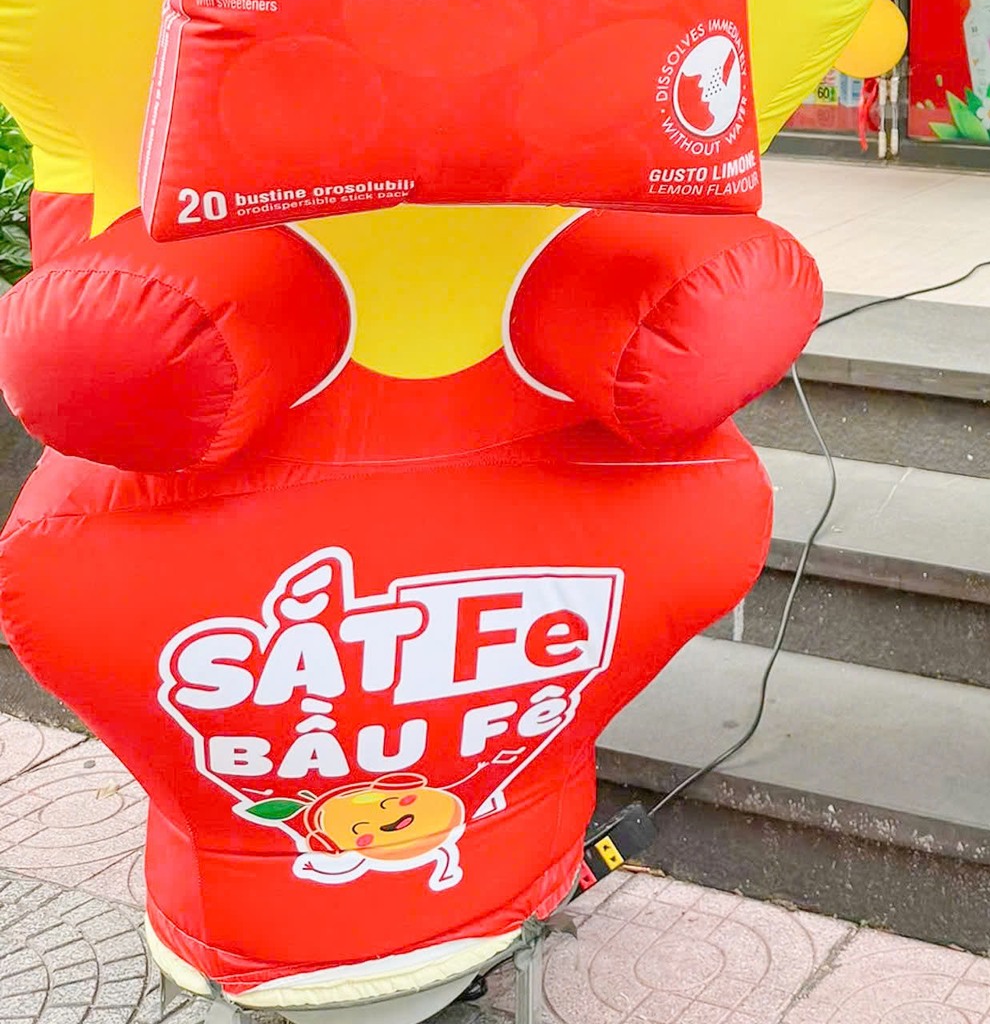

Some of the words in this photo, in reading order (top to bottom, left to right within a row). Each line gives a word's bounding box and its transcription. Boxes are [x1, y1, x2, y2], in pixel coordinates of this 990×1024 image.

[655, 23, 706, 102] DISSOLVES
[707, 18, 748, 77] IMMEDIATELY
[661, 115, 721, 157] WITHOUT
[725, 97, 748, 146] WATER
[648, 184, 703, 196] LEMON
[706, 171, 760, 197] FLAVOUR
[650, 166, 708, 183] GUSTO
[712, 149, 757, 181] LIMONE
[177, 187, 229, 225] 20
[234, 188, 307, 207] bustine
[236, 195, 337, 217] orodispersible
[340, 191, 373, 202] stick
[175, 564, 425, 711] SẮT
[453, 592, 590, 683] Fe
[208, 697, 428, 778] BẦU
[460, 685, 569, 757] Fê
